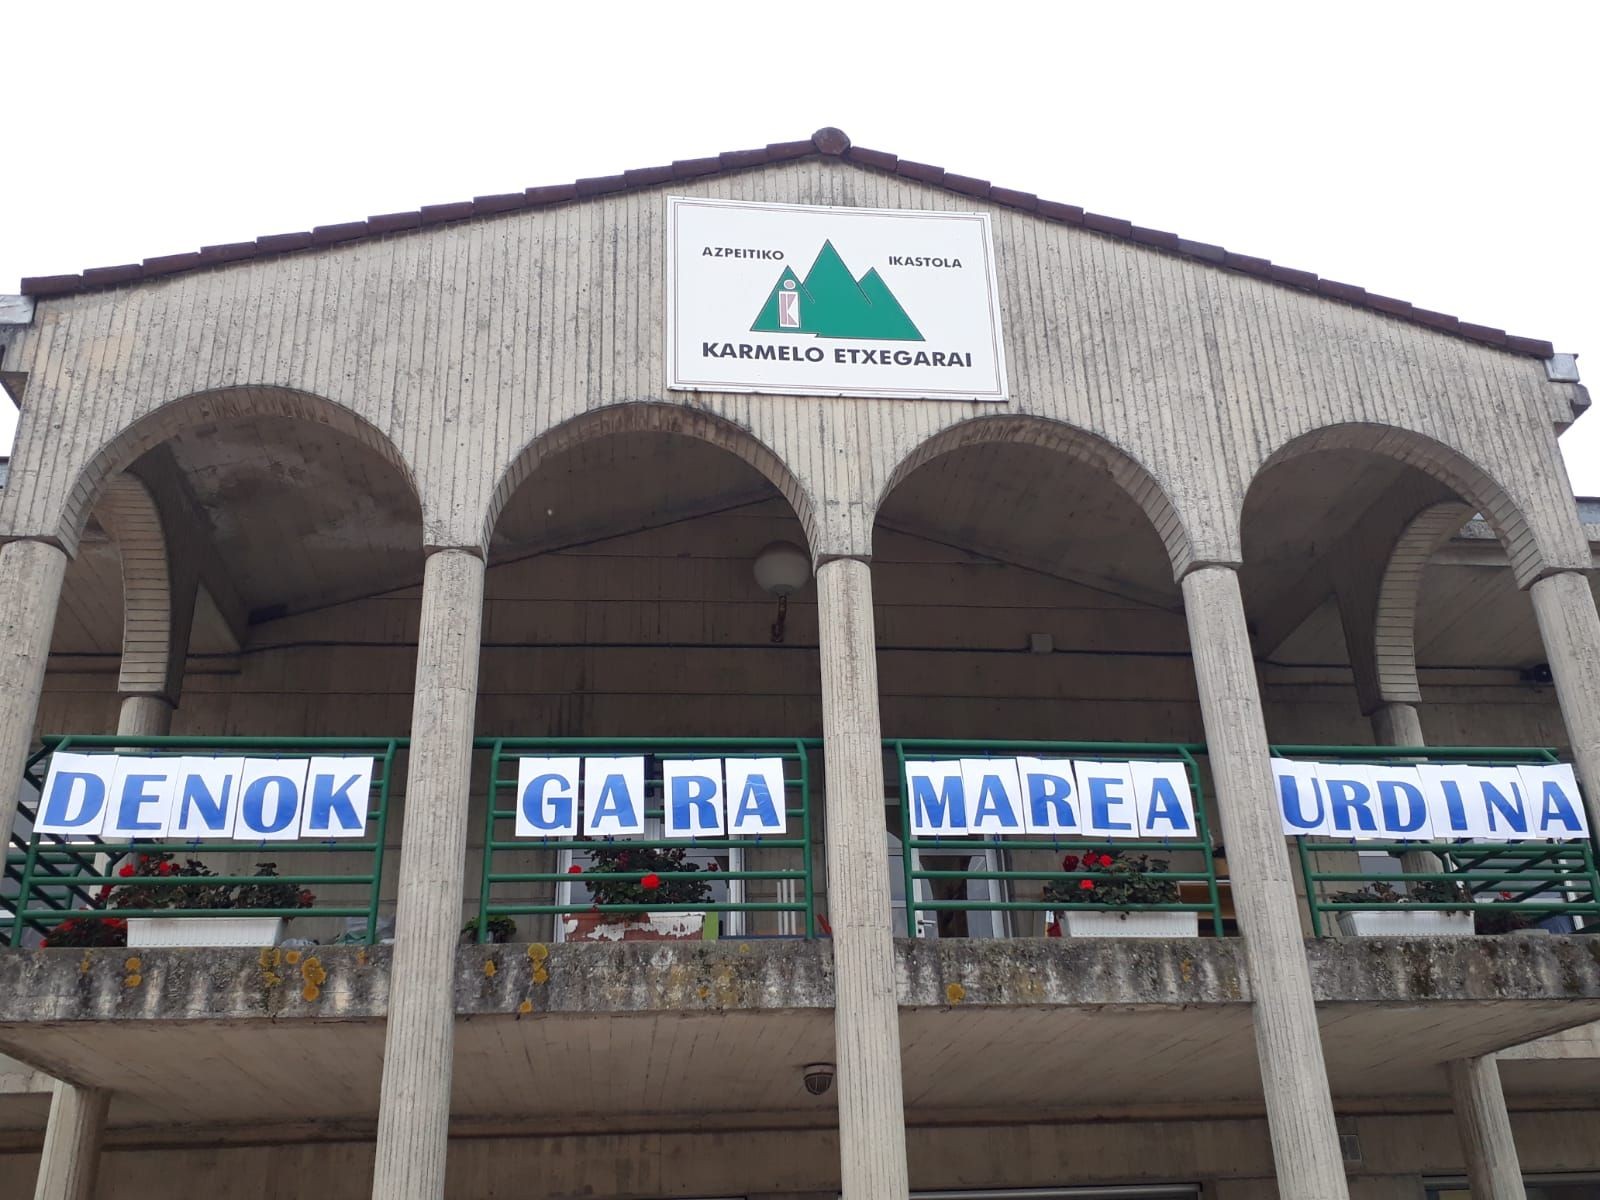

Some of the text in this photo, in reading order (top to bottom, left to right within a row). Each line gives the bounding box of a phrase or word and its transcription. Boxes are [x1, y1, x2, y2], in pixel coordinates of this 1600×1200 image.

[702, 246, 962, 268] AZPEITIKO IKASTOLA
[703, 341, 972, 367] KARMELO ETXEGARAI
[42, 771, 1583, 834] DENOK GARA MAREA URDINA
